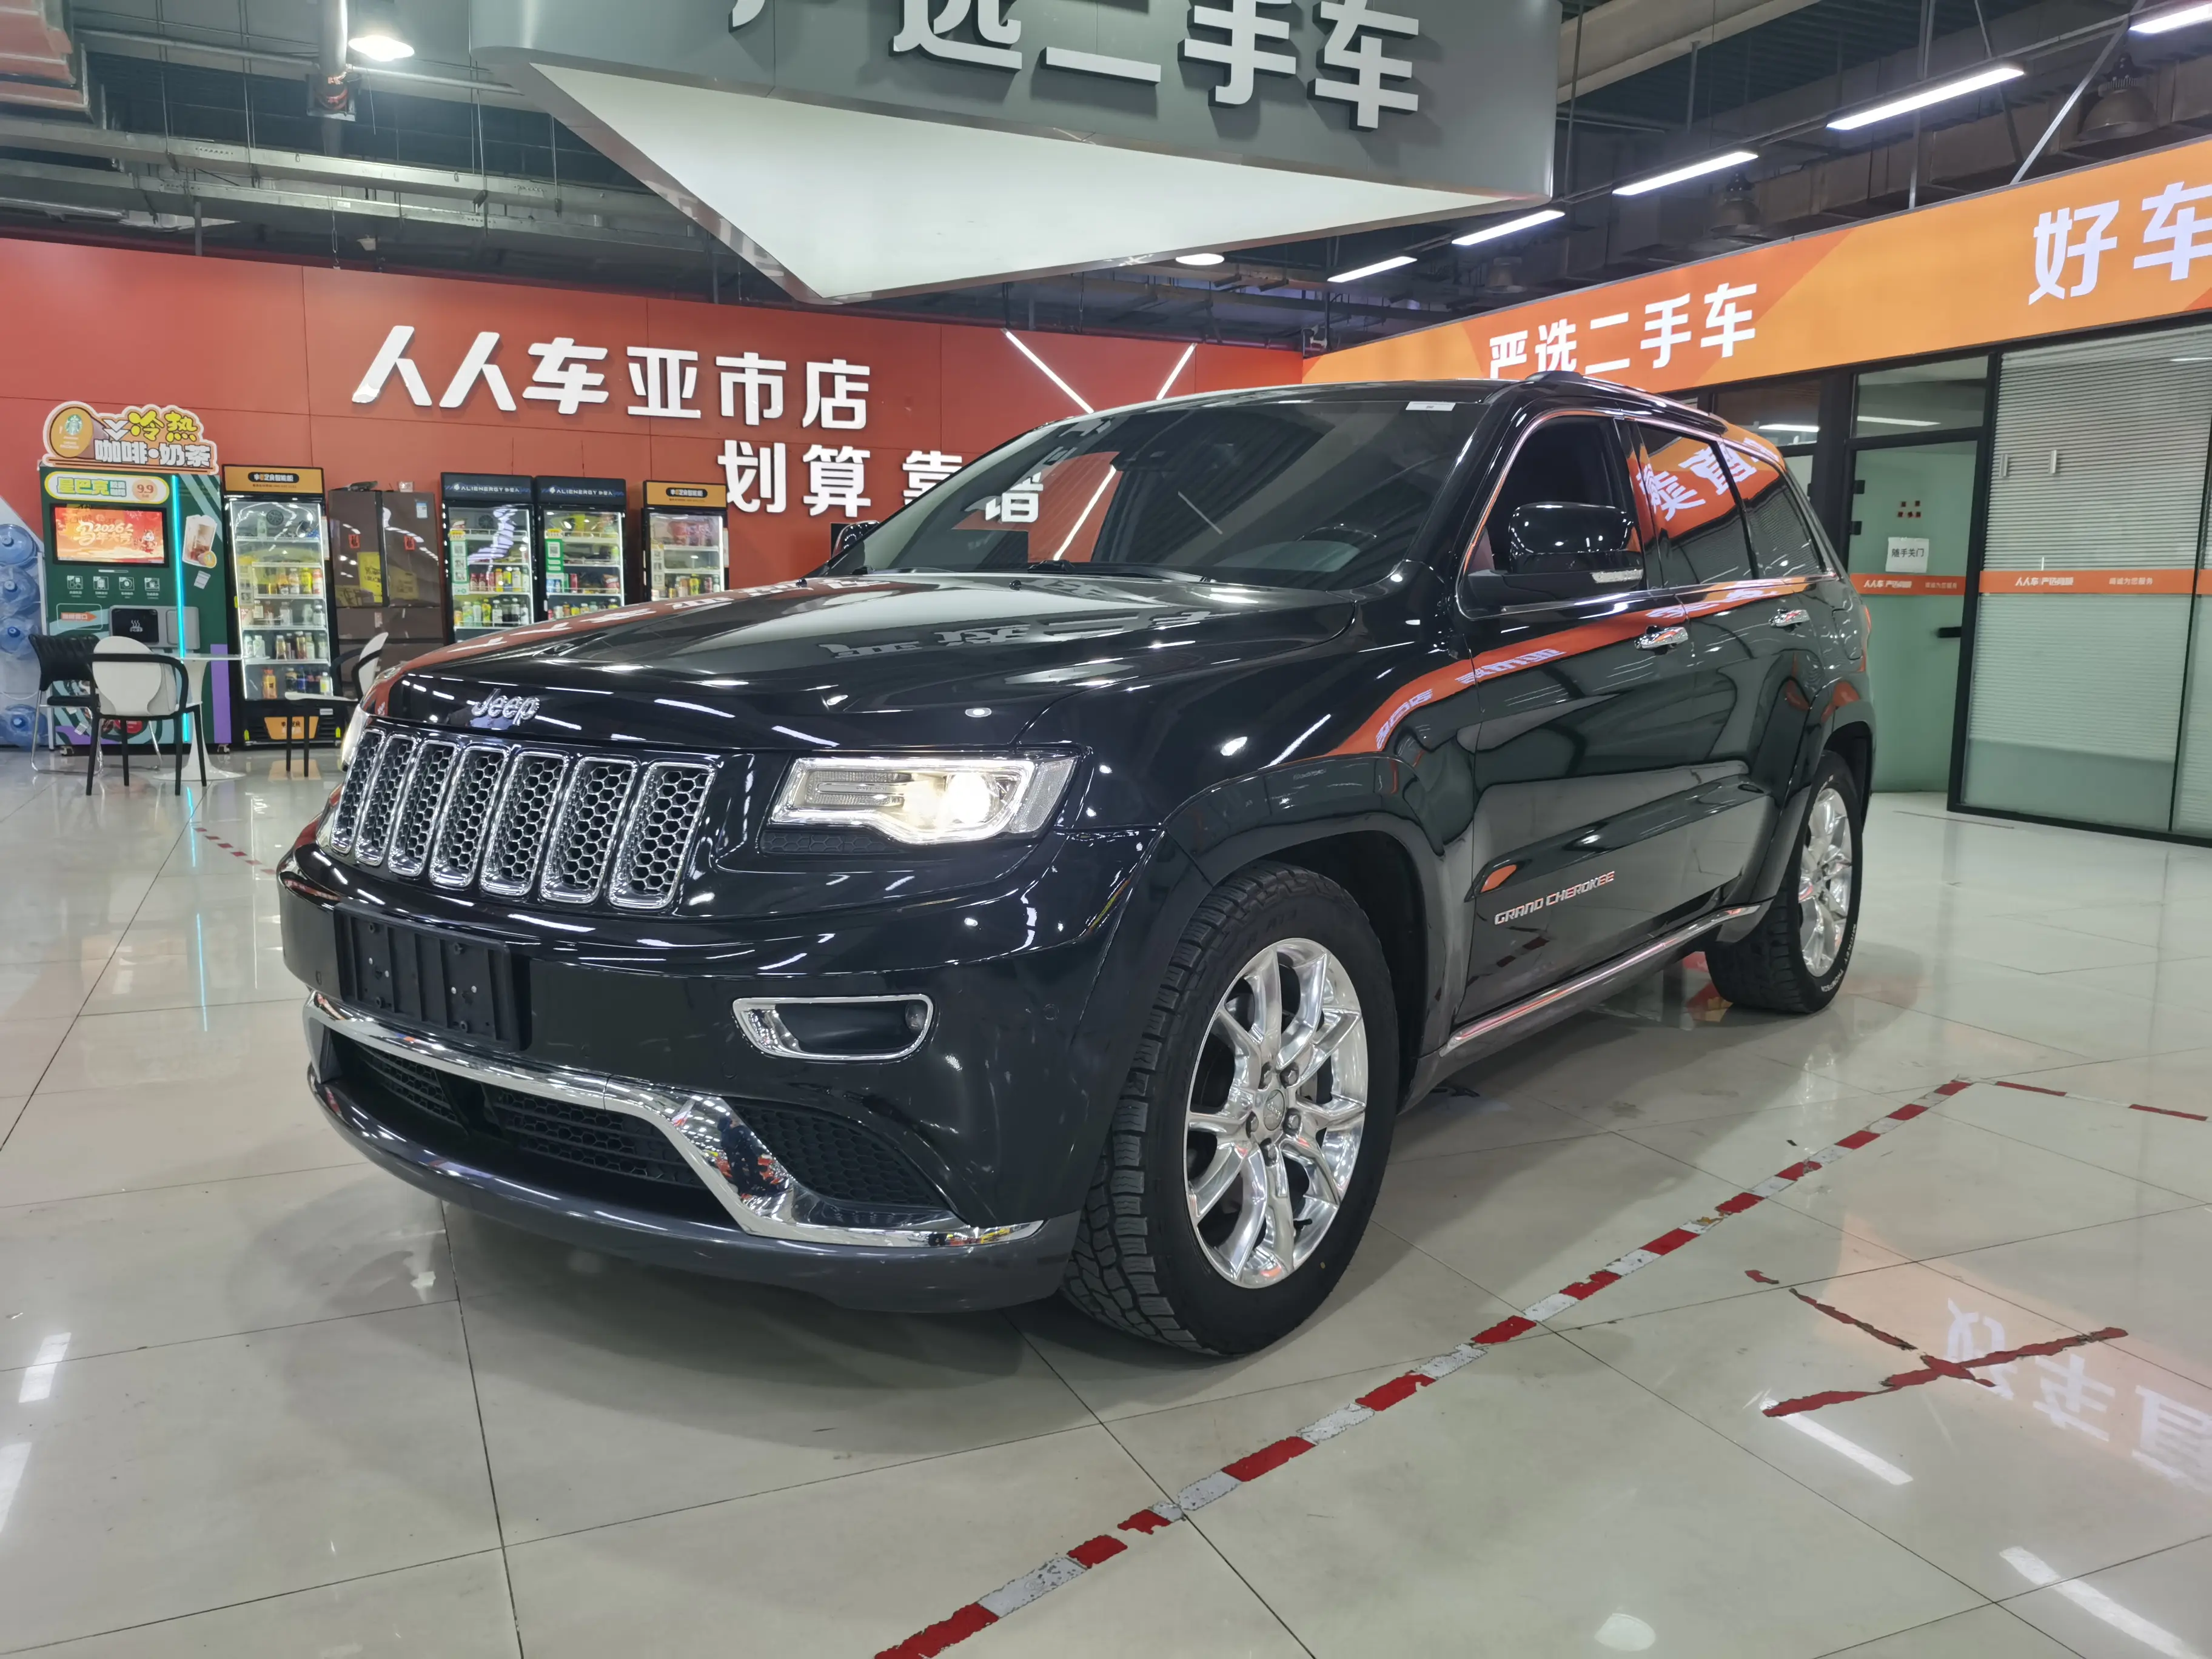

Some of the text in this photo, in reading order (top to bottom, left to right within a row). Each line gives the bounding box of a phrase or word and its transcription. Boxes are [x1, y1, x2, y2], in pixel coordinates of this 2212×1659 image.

[732, 0, 1419, 129] 选二手车
[2028, 181, 2212, 305] 好车
[1489, 283, 1757, 379] 严选二手车
[352, 324, 871, 429] 人人车亚市店
[128, 411, 197, 442] 冷热
[717, 440, 871, 517] 划算
[94, 523, 124, 534] 2026
[1891, 548, 1925, 557] 随手关门
[471, 688, 540, 726] Jeep
[1493, 870, 1615, 925] GRAND CHEROKEE
[1843, 923, 1857, 965] MICKEY
